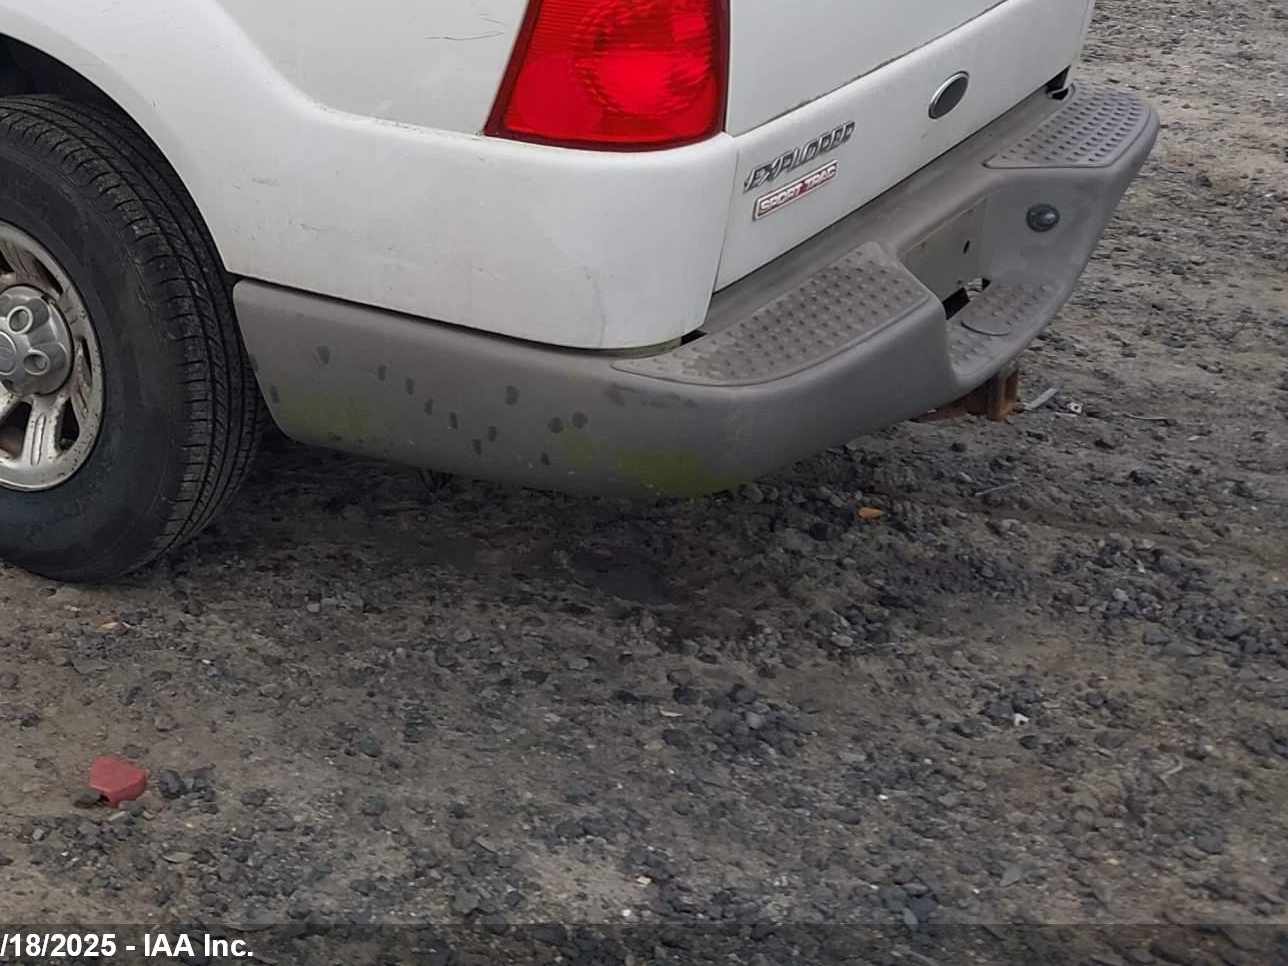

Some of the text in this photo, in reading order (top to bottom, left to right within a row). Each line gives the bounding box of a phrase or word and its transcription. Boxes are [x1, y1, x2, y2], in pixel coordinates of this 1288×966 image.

[744, 121, 856, 192] EXPLORER
[759, 165, 837, 211] SPORT TRAC
